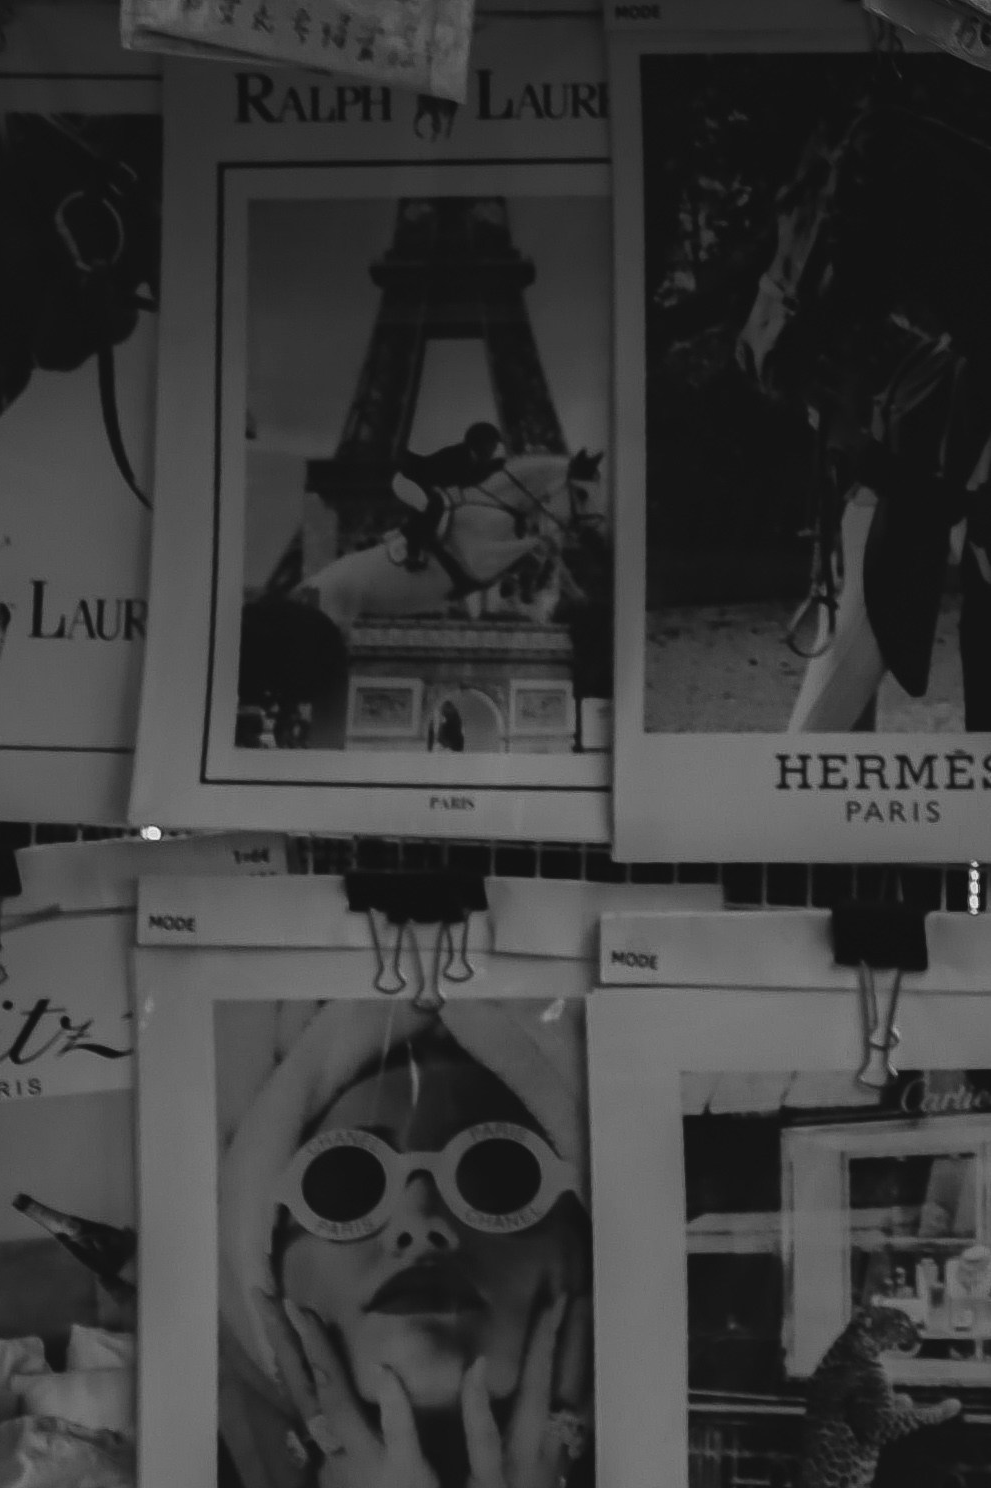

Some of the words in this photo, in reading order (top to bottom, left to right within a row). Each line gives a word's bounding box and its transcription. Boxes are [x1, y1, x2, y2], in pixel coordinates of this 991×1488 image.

[233, 71, 393, 124] RALPH
[475, 68, 608, 121] LAUR
[773, 750, 991, 792] HERMÈS
[428, 796, 477, 812] PARIS
[845, 800, 942, 824] PARIS
[147, 914, 197, 933] MODE
[610, 949, 660, 971] MODE
